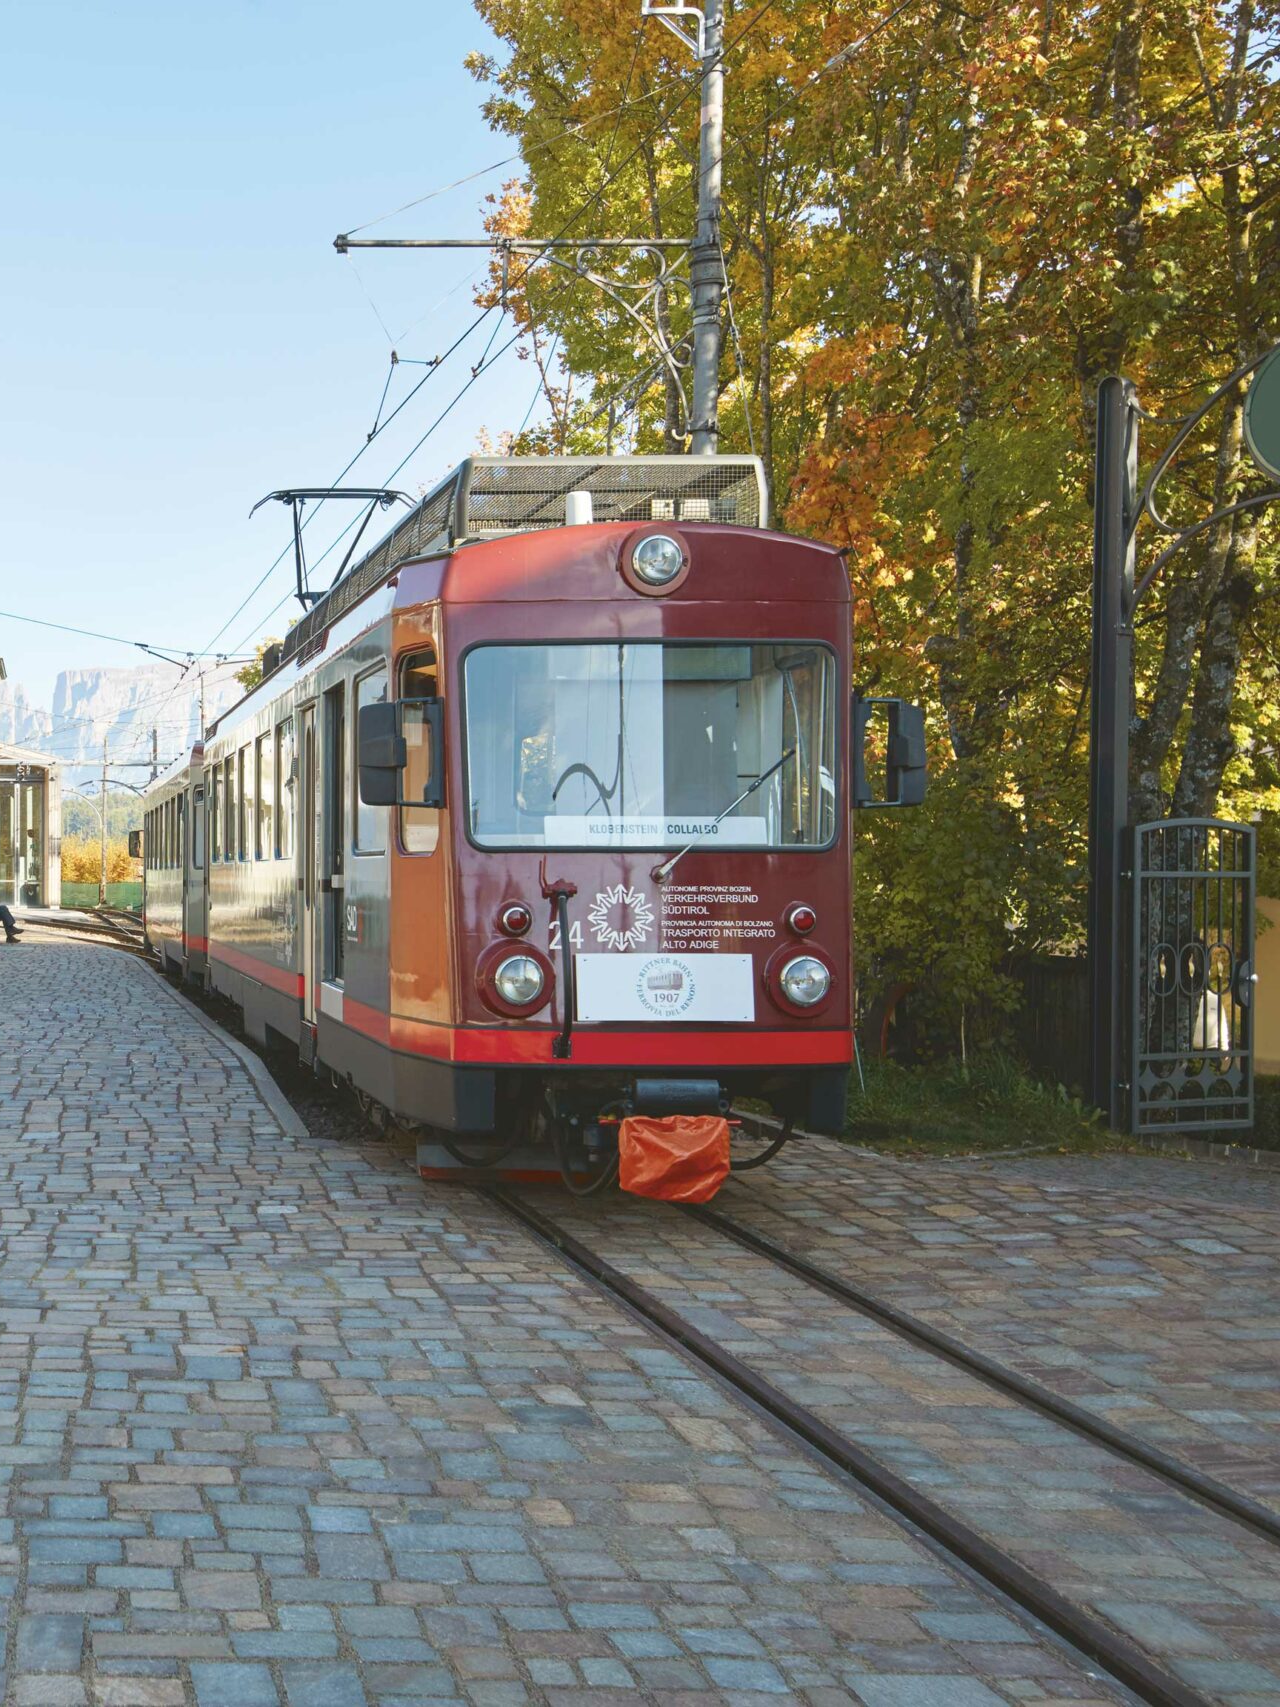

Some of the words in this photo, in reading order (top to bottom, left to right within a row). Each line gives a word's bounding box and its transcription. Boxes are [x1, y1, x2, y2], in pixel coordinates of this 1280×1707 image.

[589, 824, 658, 834] KLOBENSTEIN
[661, 894, 758, 903] VERKEHRSVERBUND
[661, 905, 710, 914] SÜDTIROL
[662, 929, 720, 938] TRASPORTO
[723, 929, 776, 938] INTEGRATO
[662, 940, 686, 949] ALTO
[689, 940, 719, 949] ADIGE
[639, 958, 670, 978] RITTNER
[672, 960, 691, 977] BAHN
[636, 984, 662, 1016] FERROVIA
[665, 1008, 681, 1016] DEL
[680, 984, 696, 1011] RENON
[654, 993, 680, 1003] 1907
